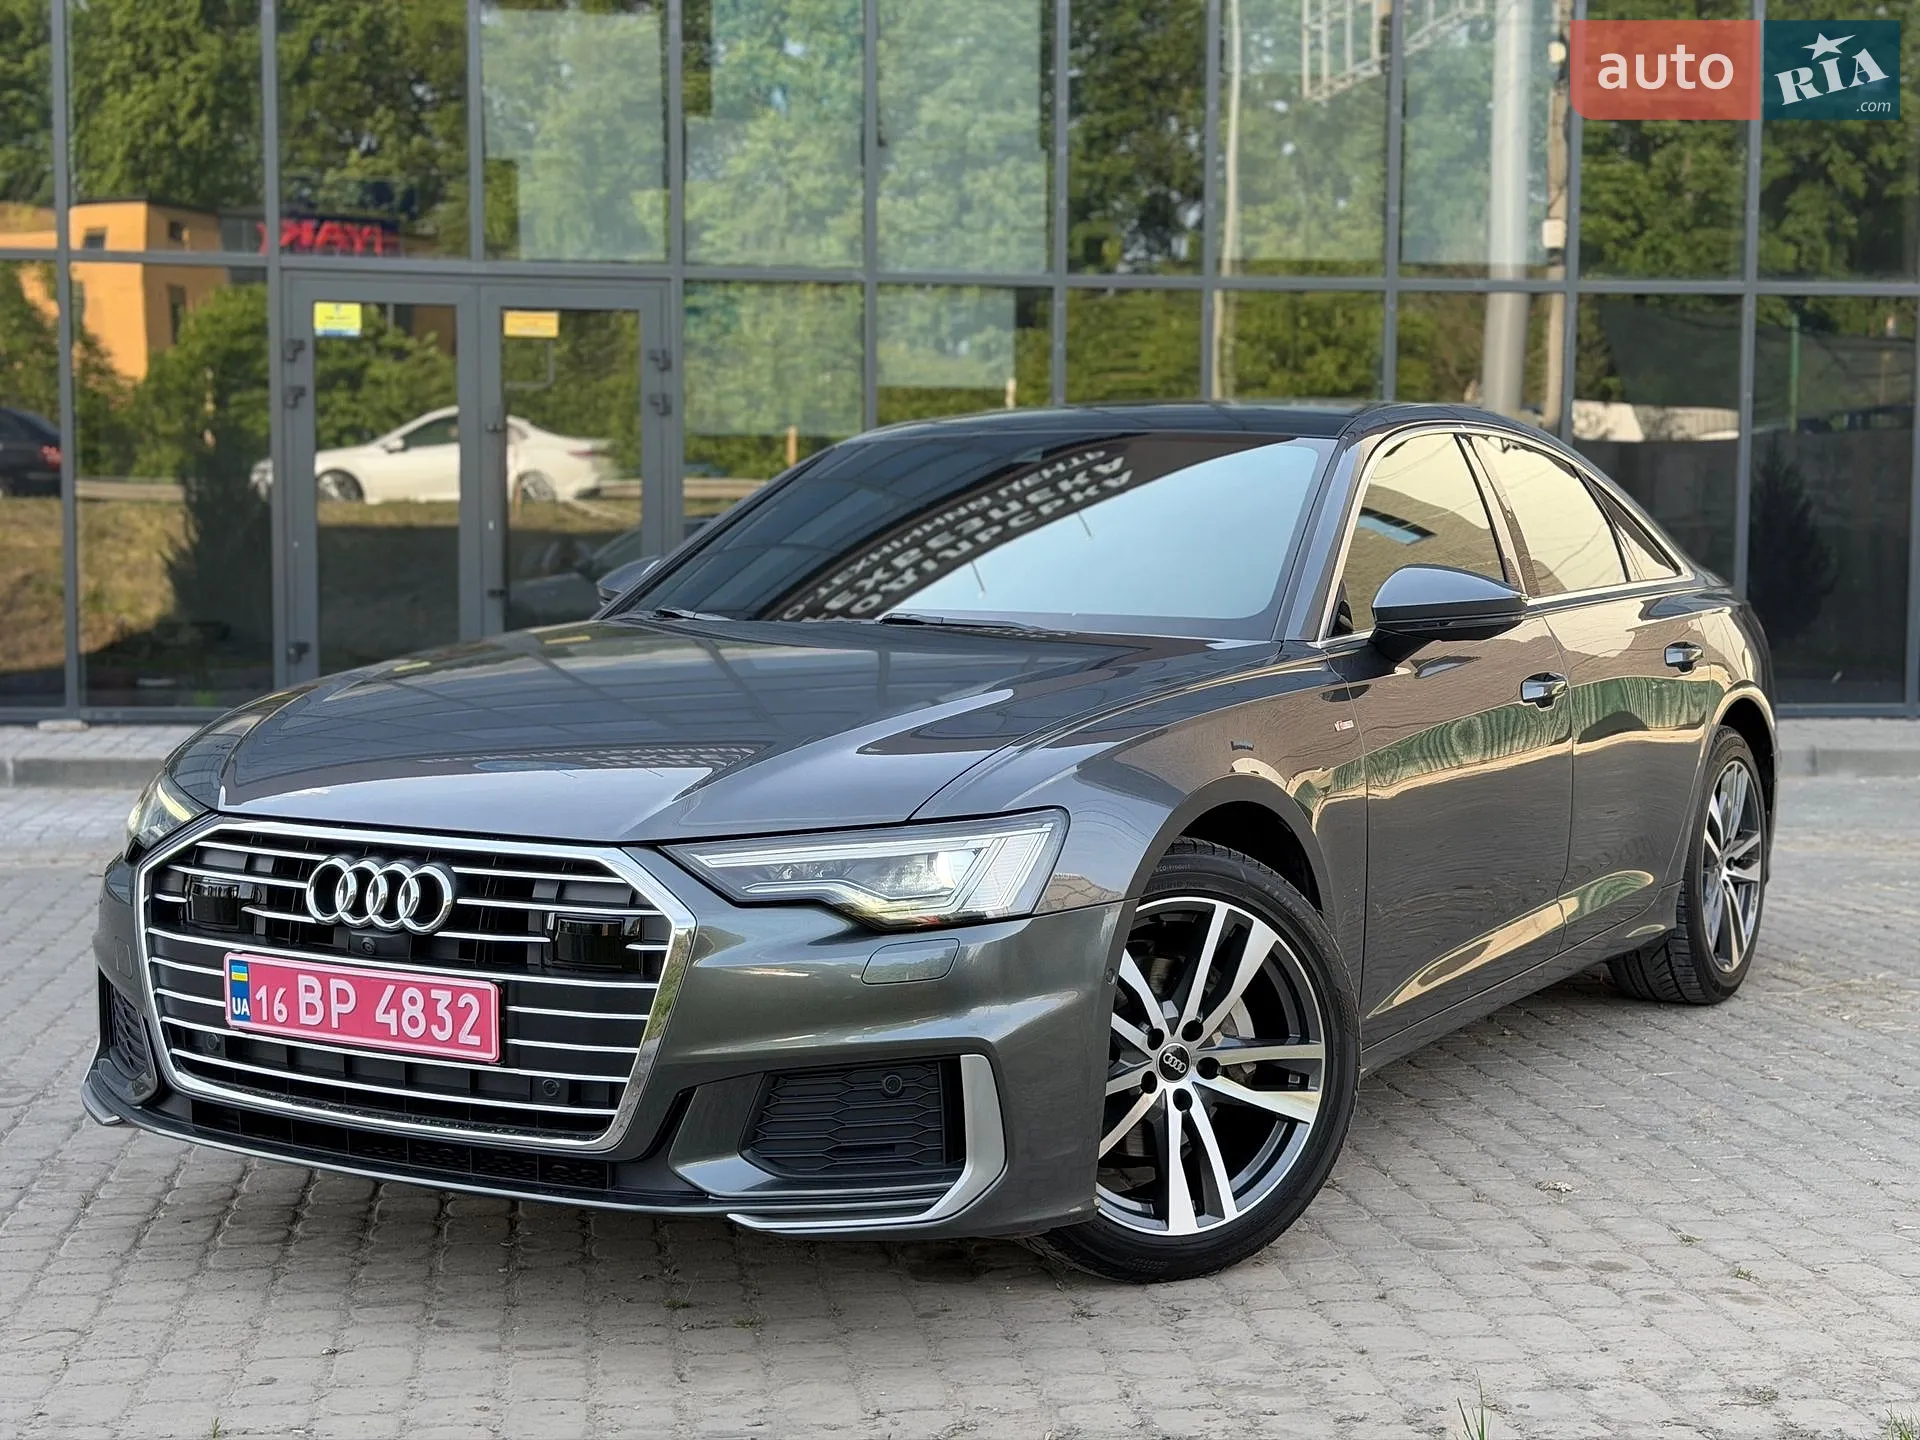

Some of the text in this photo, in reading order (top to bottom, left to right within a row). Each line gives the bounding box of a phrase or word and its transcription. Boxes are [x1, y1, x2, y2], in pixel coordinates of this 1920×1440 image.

[232, 997, 250, 1017] UA
[255, 973, 481, 1046] 16 BP 4832
